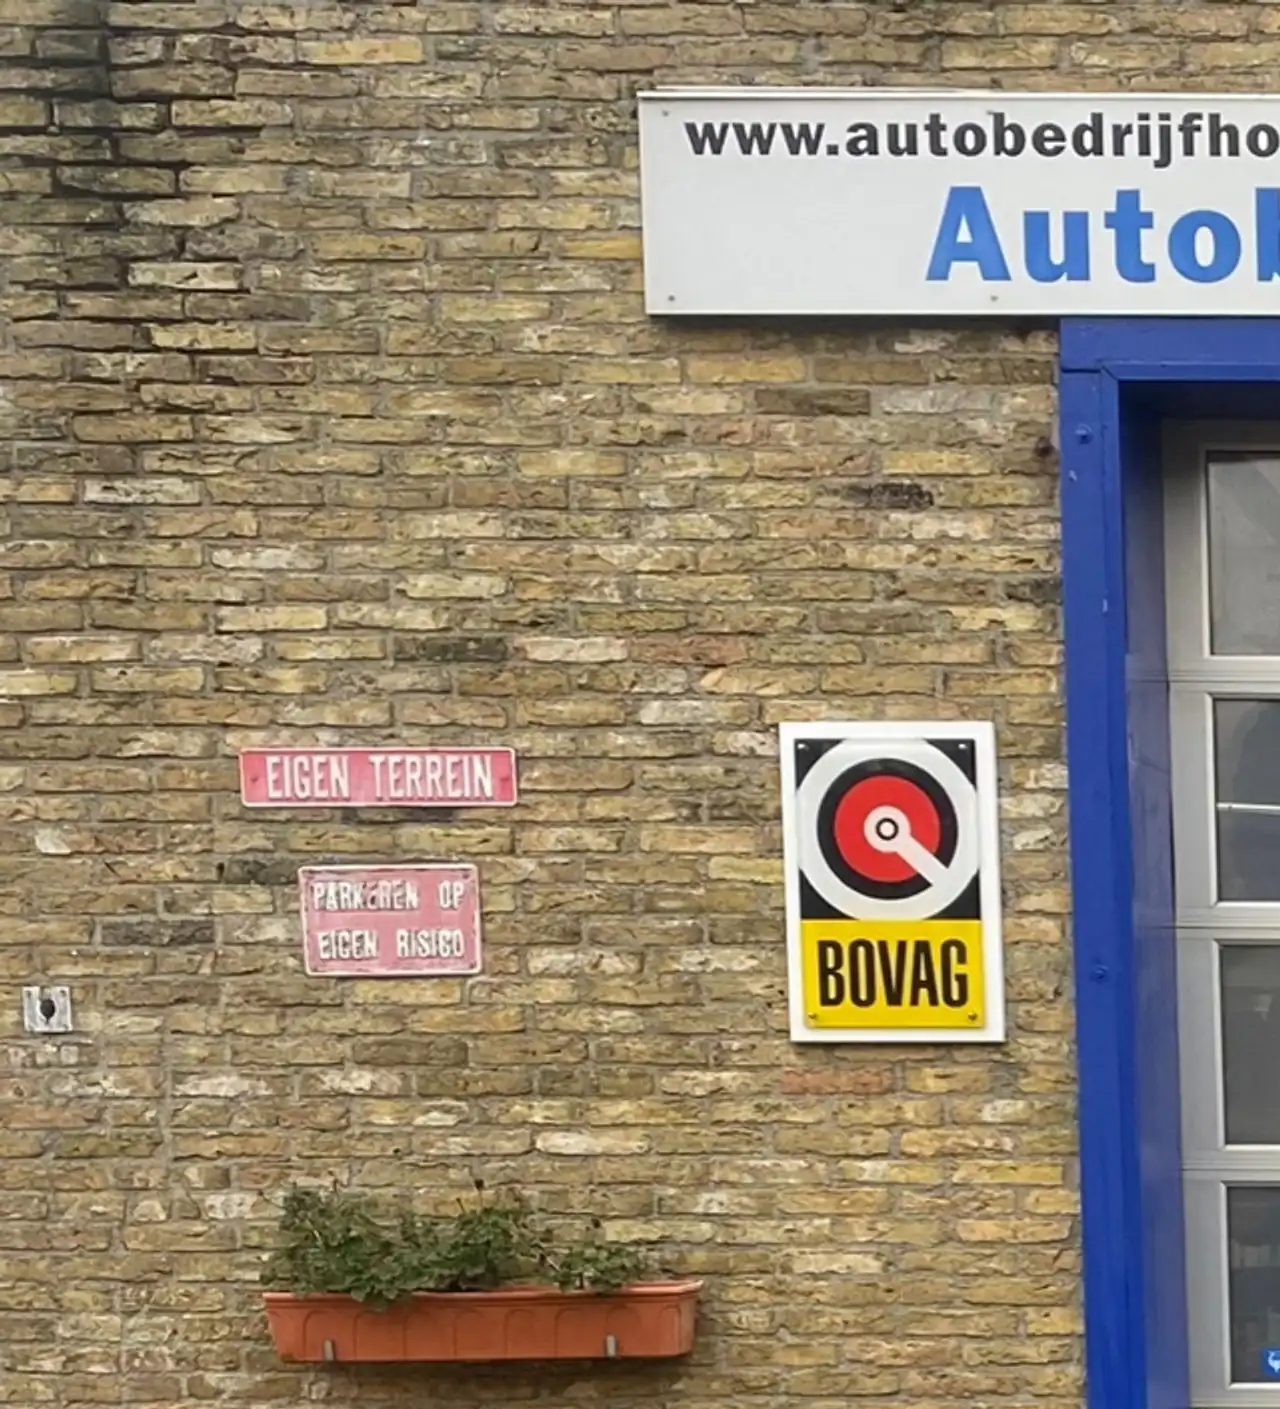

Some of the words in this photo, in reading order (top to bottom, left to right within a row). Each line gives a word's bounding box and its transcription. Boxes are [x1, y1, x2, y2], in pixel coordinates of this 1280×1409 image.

[266, 755, 350, 800] EIGEN
[368, 755, 494, 799] TERREIN
[438, 881, 465, 909] OP
[317, 932, 378, 960] EIGEN
[817, 938, 969, 1009] BOVAG
